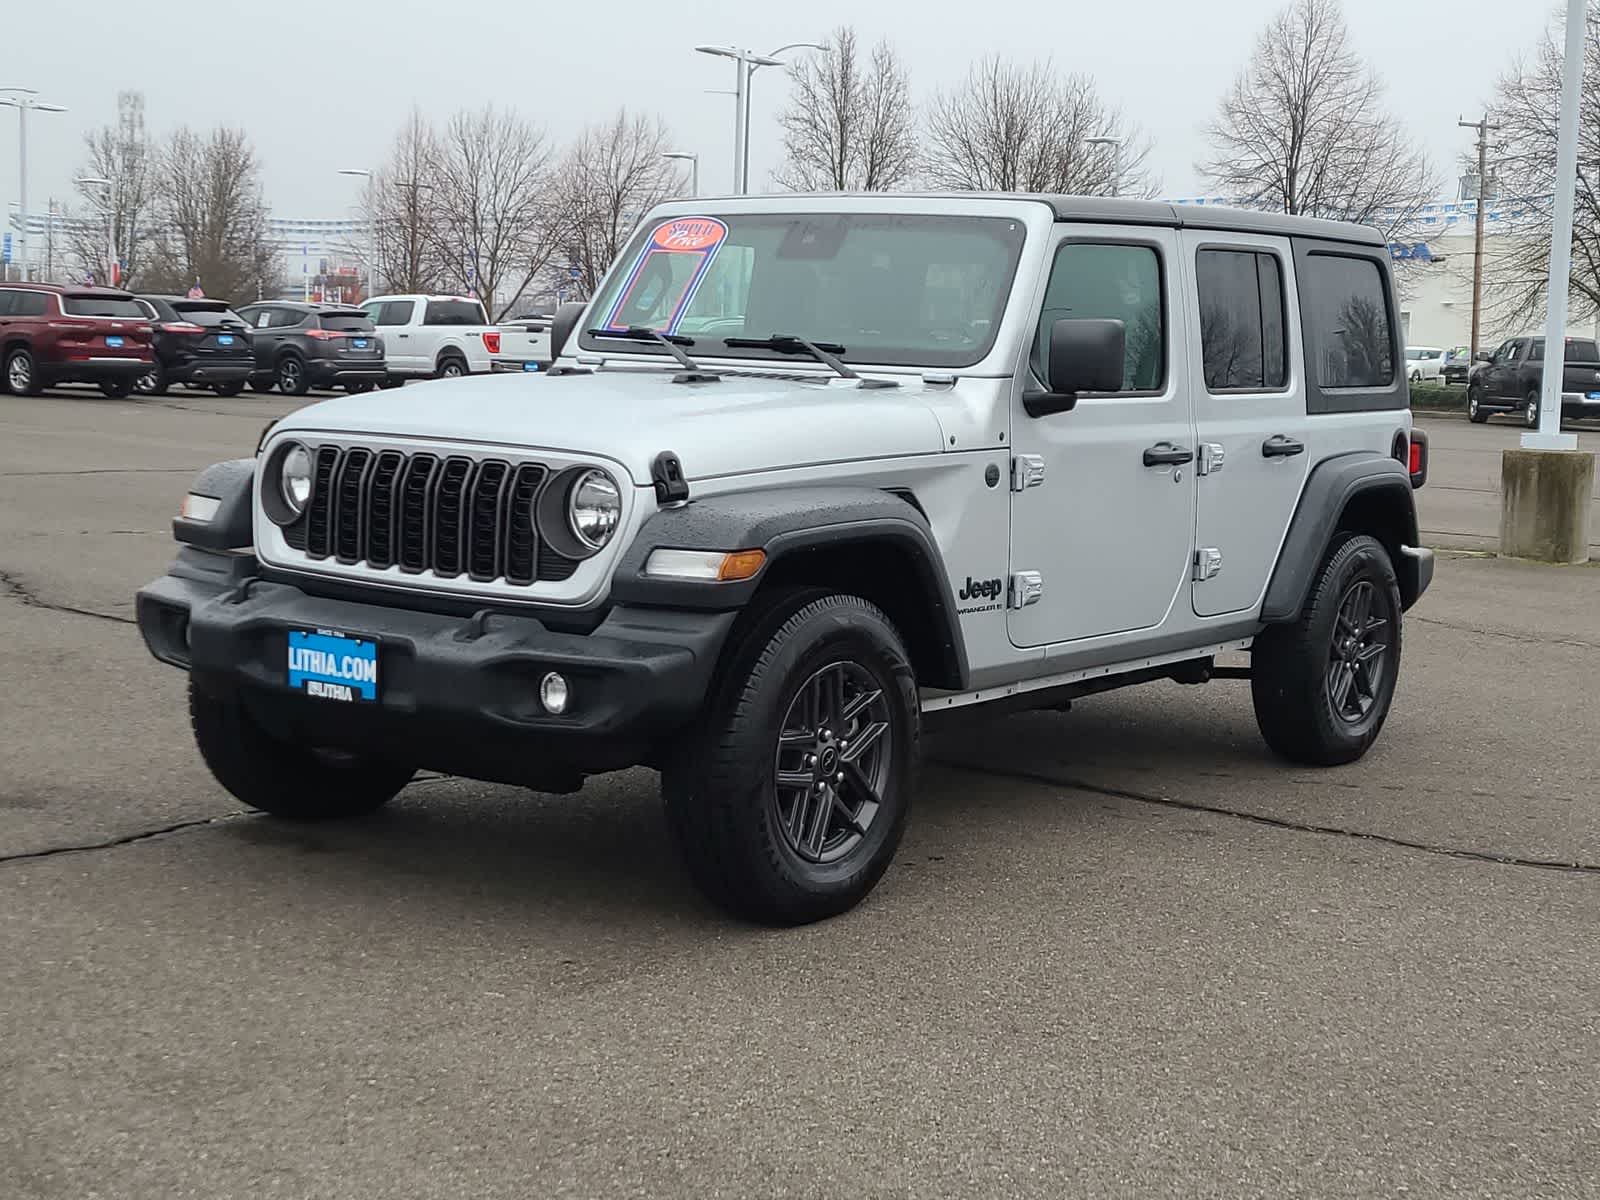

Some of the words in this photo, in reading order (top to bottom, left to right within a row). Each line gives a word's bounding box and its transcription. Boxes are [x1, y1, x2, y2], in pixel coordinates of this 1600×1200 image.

[959, 577, 1002, 600] Jeep
[288, 646, 377, 683] LITHIA.COM
[319, 682, 353, 701] LITHIA
